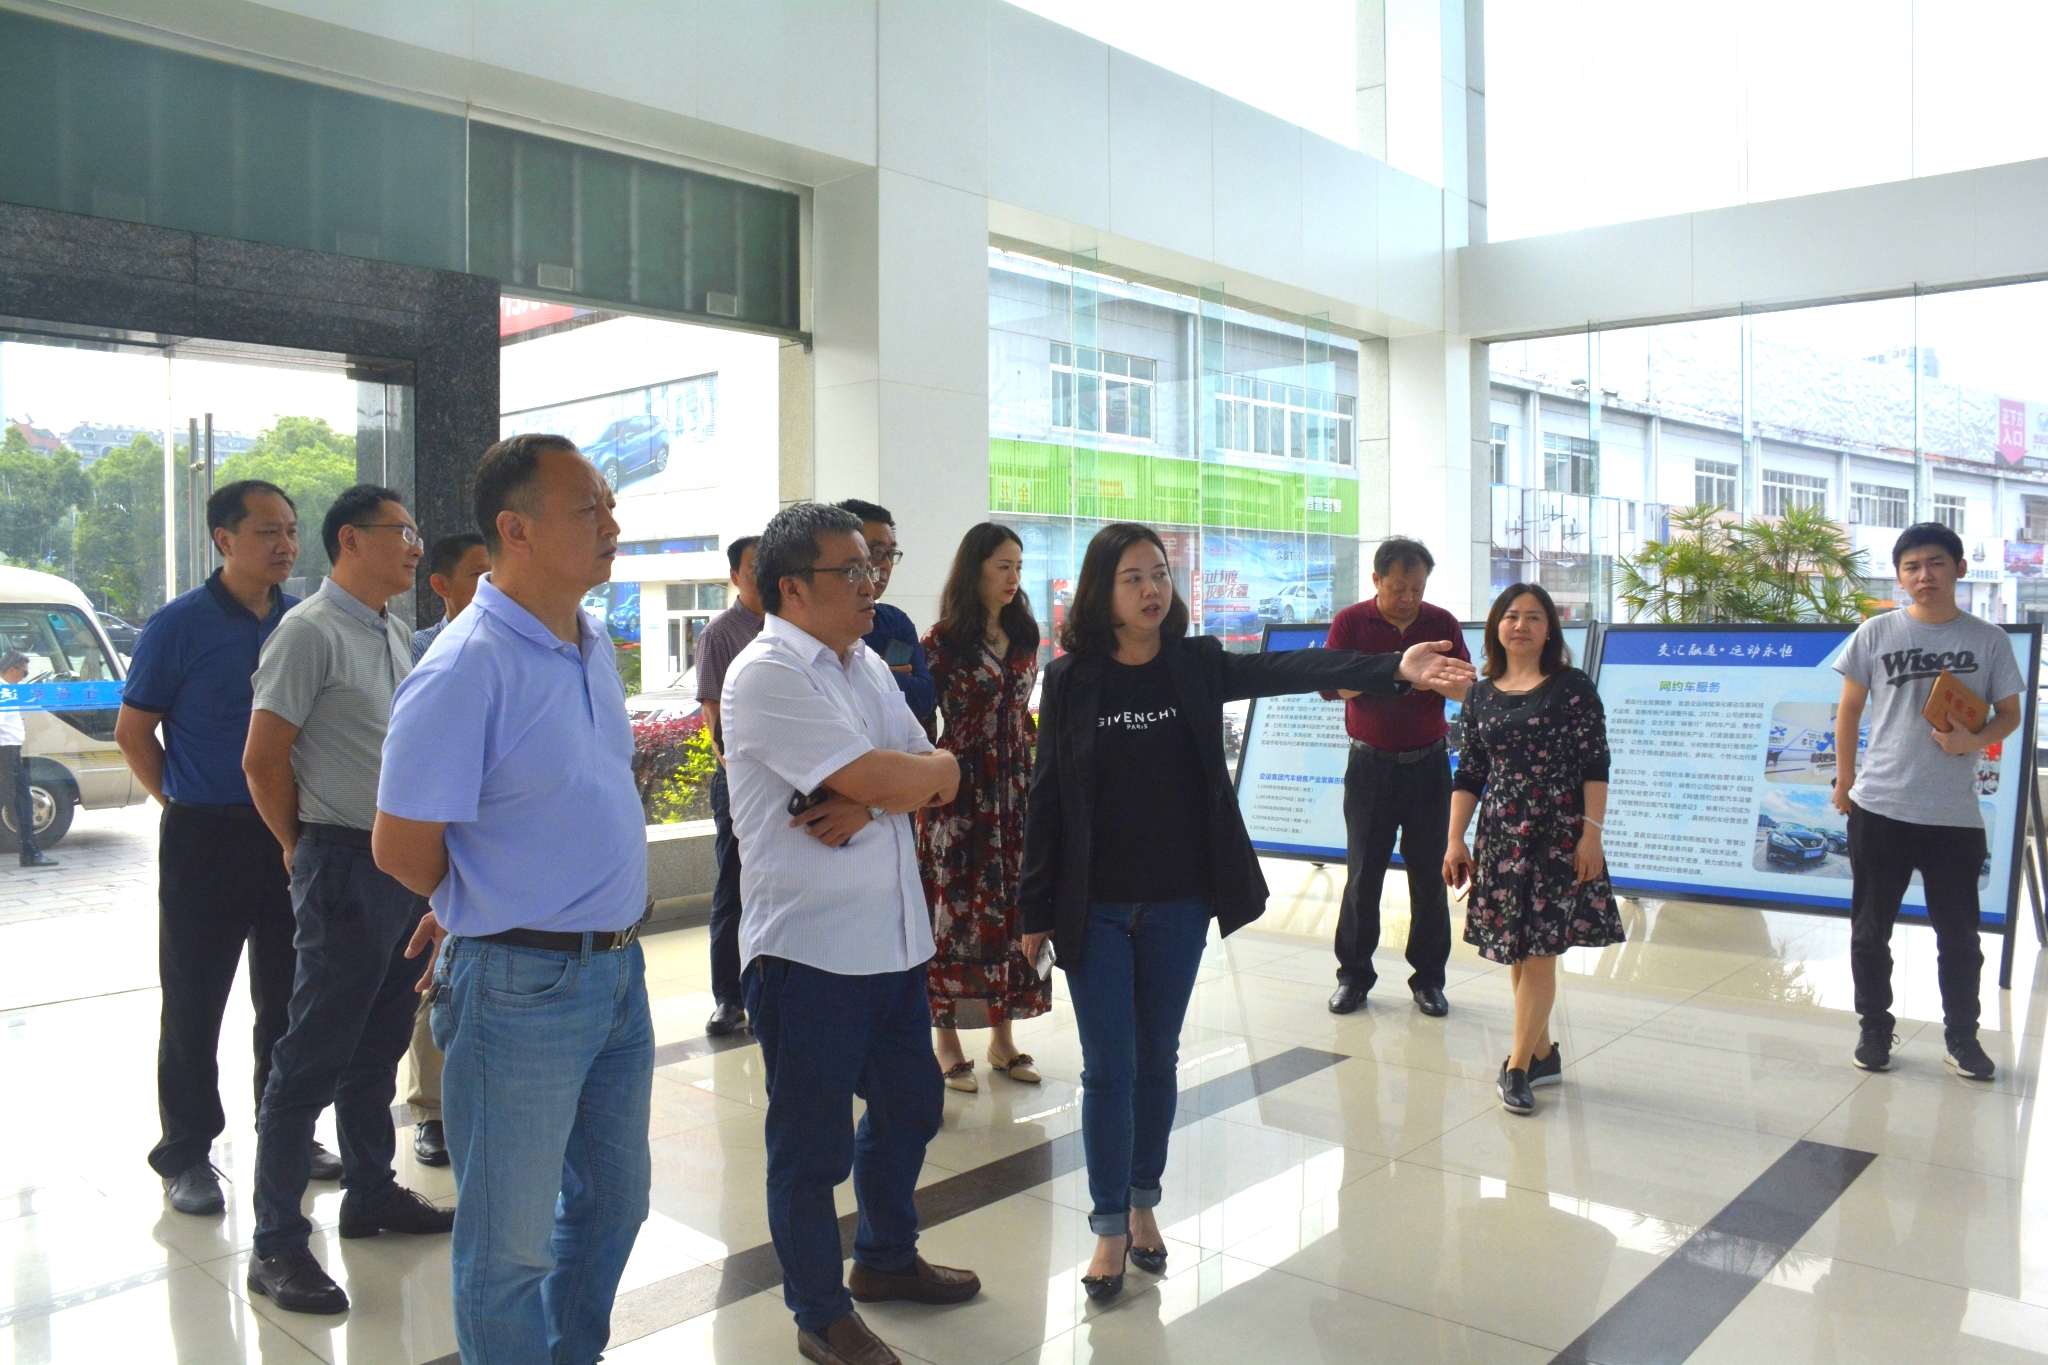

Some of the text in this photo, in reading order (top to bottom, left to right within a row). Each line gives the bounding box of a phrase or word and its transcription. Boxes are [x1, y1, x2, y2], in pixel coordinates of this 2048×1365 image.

[2002, 408, 2024, 428] 正下方
[2002, 428, 2023, 447] 入口
[1881, 648, 1978, 678] Wisco
[1659, 680, 1721, 693] 网约车服务
